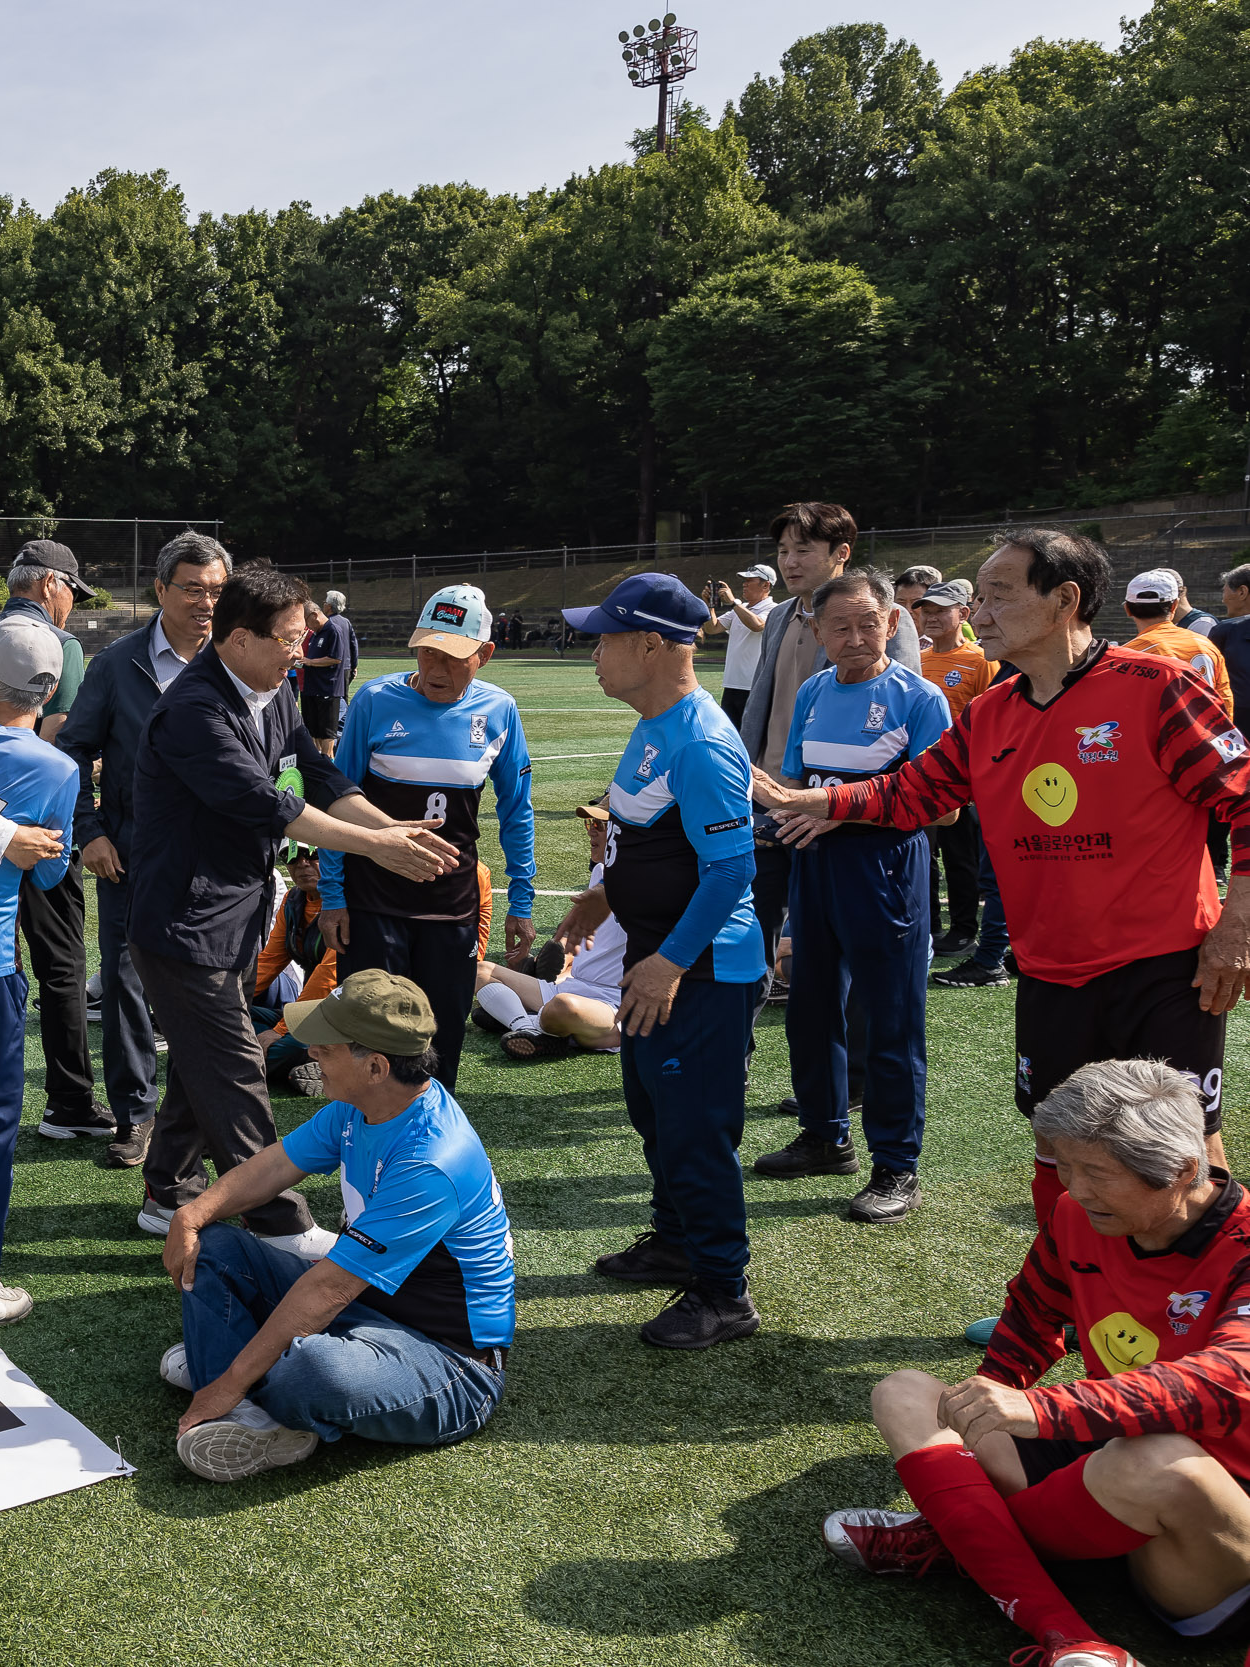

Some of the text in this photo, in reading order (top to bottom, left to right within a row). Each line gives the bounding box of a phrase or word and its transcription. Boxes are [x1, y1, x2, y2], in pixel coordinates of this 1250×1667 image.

[437, 605, 464, 618] MIAMI
[1131, 665, 1160, 680] 7580
[424, 791, 448, 830] 8
[709, 821, 739, 832] RESPECT
[1013, 832, 1113, 852] 서울글로우안과
